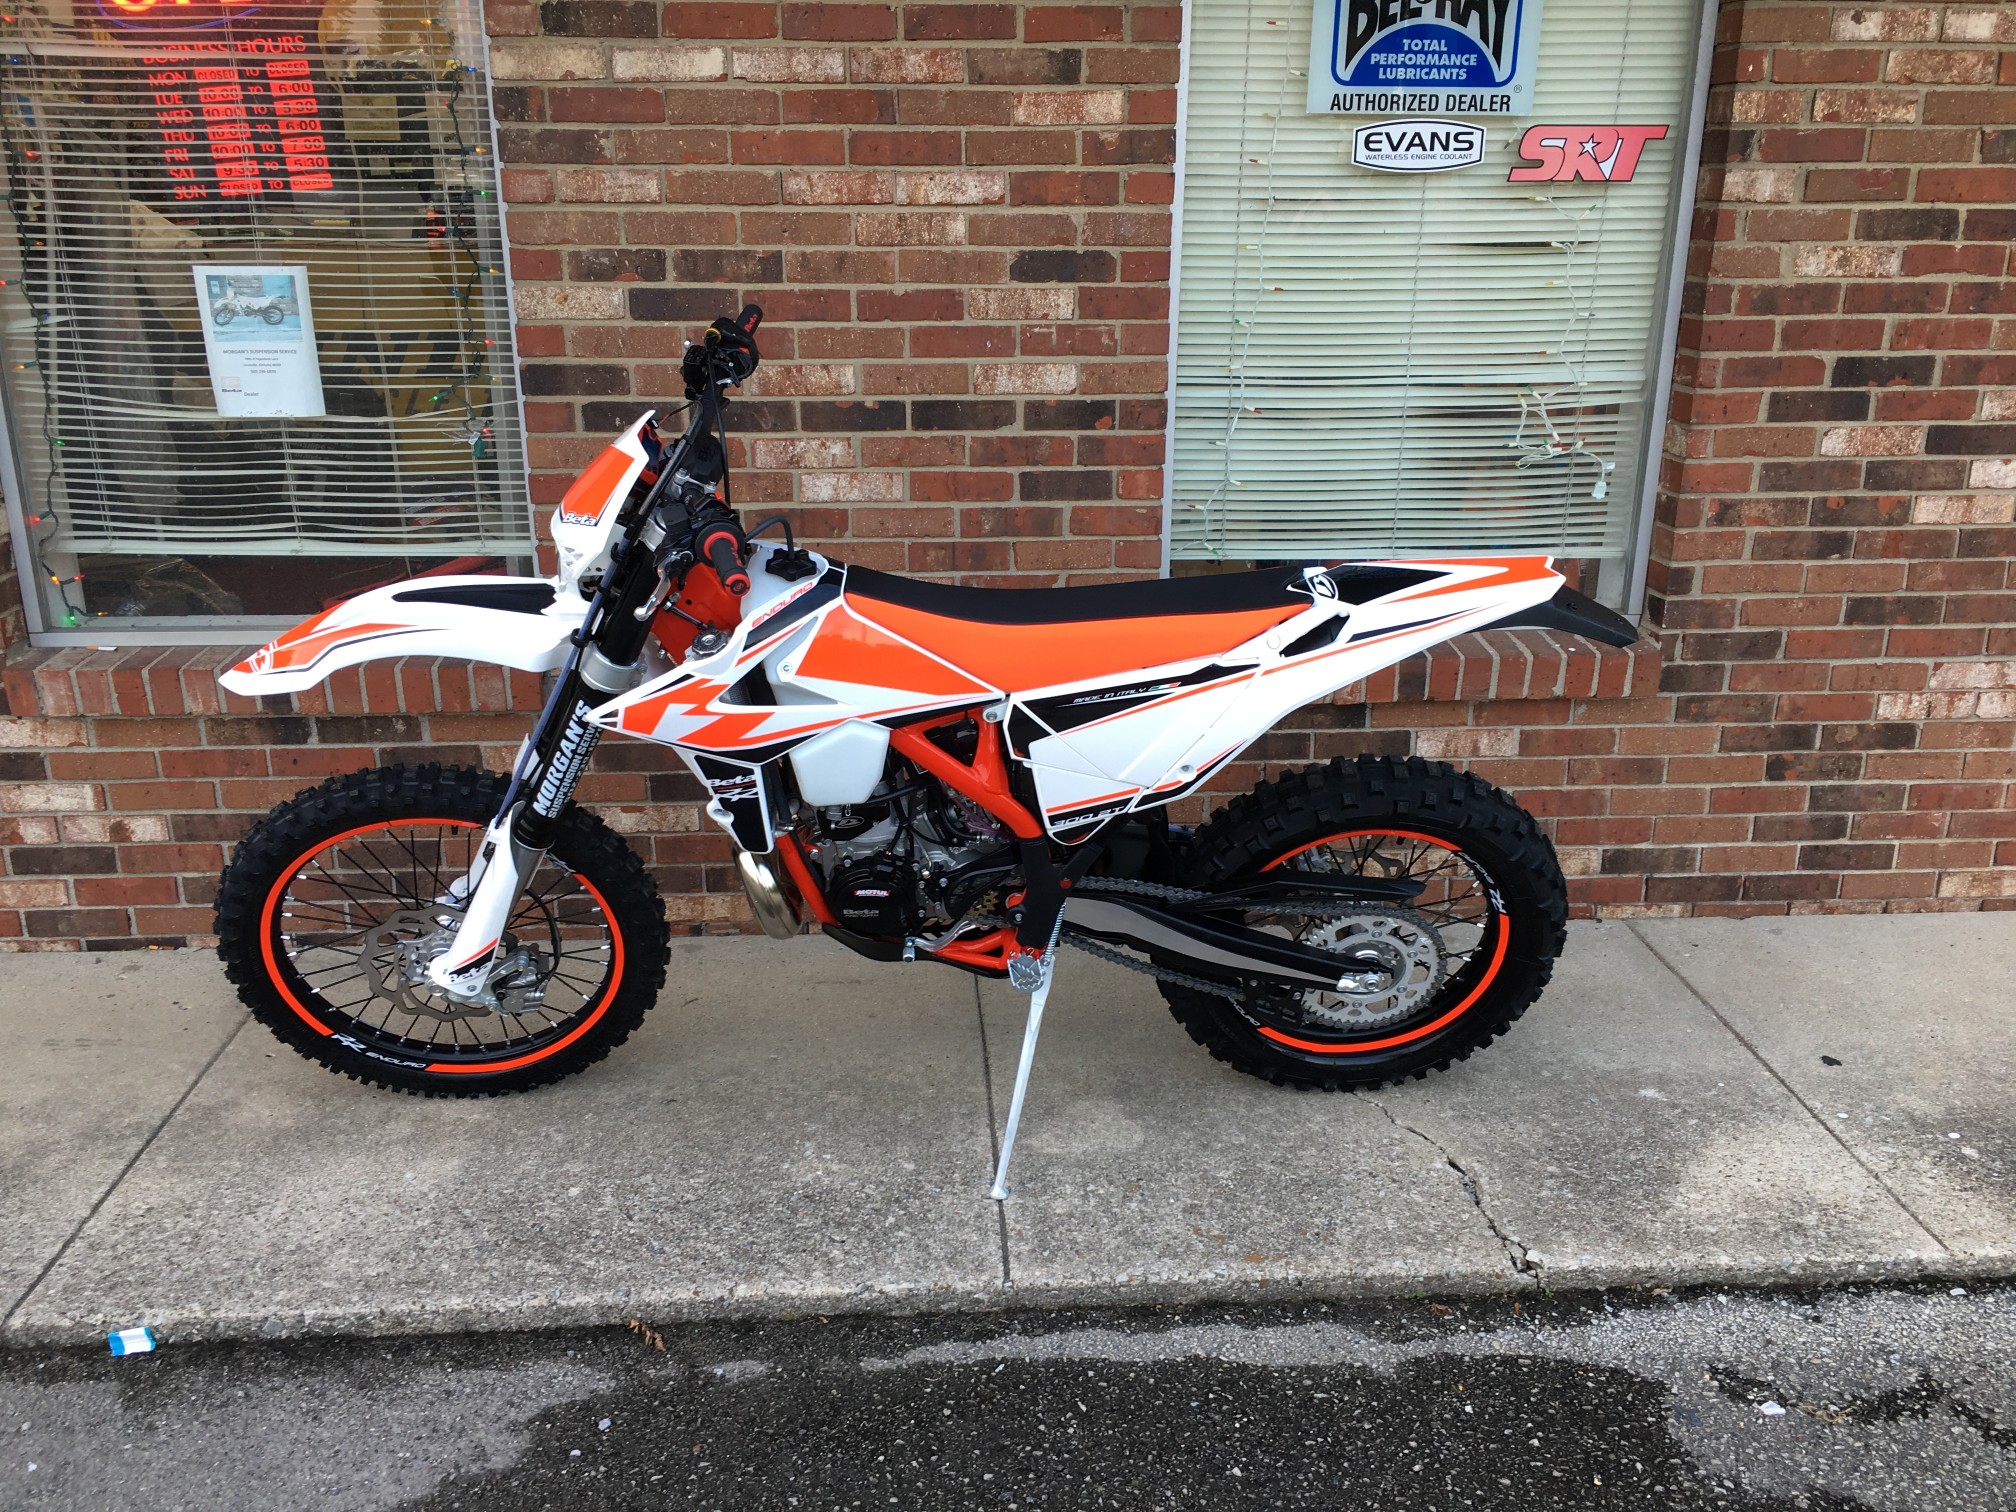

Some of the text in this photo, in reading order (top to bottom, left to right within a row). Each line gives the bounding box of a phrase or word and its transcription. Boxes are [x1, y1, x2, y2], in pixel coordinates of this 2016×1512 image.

[236, 35, 307, 54] HOURS
[1402, 39, 1448, 51] TOTAL
[1370, 53, 1478, 66] PERFORMANCE
[148, 63, 307, 86] MON CLOSED TO CLOSED
[1378, 67, 1467, 80] LUBRICANTS
[155, 92, 184, 106] TUE
[248, 85, 264, 95] TO
[278, 82, 311, 93] 6:00
[1330, 93, 1511, 112] AUTHORIZED DEALER
[156, 108, 194, 124] WED
[251, 105, 268, 115] TO
[162, 130, 195, 142] THU
[255, 123, 272, 133] TO
[285, 119, 317, 131] 6:00
[1363, 131, 1474, 152] EVANS
[165, 147, 189, 163] FRI
[260, 142, 276, 152] TO
[1365, 153, 1409, 161] WATERLESS
[1506, 124, 1670, 182] SRT
[169, 166, 195, 179] SAT
[263, 161, 279, 171] TO
[174, 184, 207, 199] SUN
[268, 180, 284, 190] TO
[562, 511, 598, 526] Beta
[752, 581, 814, 628] ENDURO
[1073, 694, 1103, 704] MADE
[1116, 687, 1147, 697] ITALY
[532, 699, 593, 816] MORGAN'S
[547, 722, 597, 819] SUSPENSION SERVI
[365, 1051, 427, 1068] ENDURO
